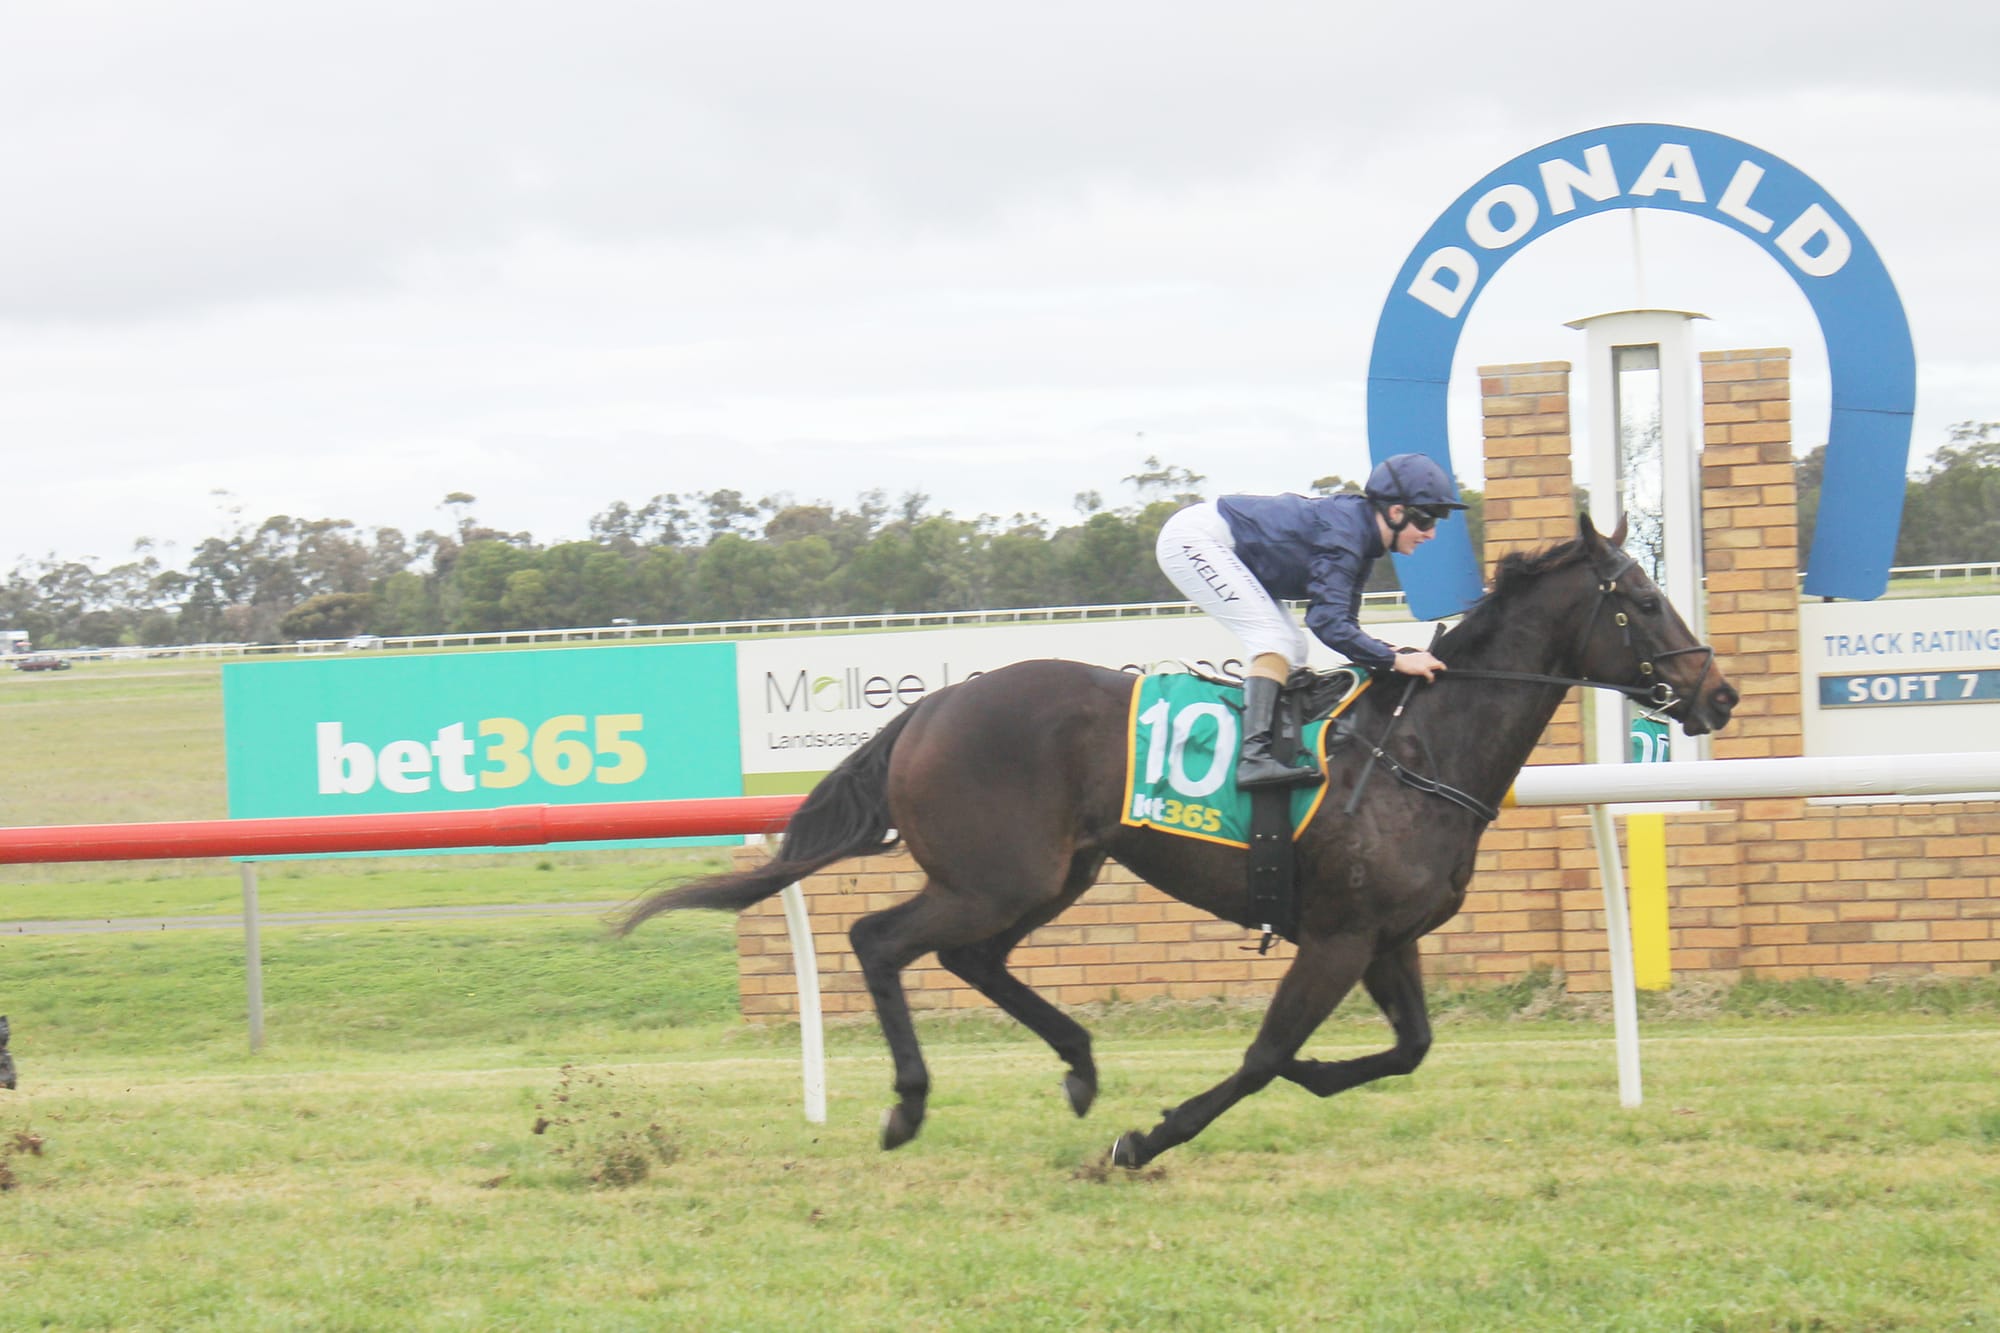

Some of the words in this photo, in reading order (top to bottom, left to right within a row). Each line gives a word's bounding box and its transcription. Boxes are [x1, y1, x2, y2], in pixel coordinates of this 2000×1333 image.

[1407, 143, 1852, 318] DONALD
[1824, 632, 1902, 657] TRACK
[1911, 628, 2000, 654] RATING
[766, 667, 926, 713] Mallee
[1847, 675, 1941, 702] SOFT
[1957, 673, 1980, 698] 7
[316, 713, 647, 794] bet365
[1139, 698, 1237, 797] 10
[1132, 793, 1222, 832] bt365
